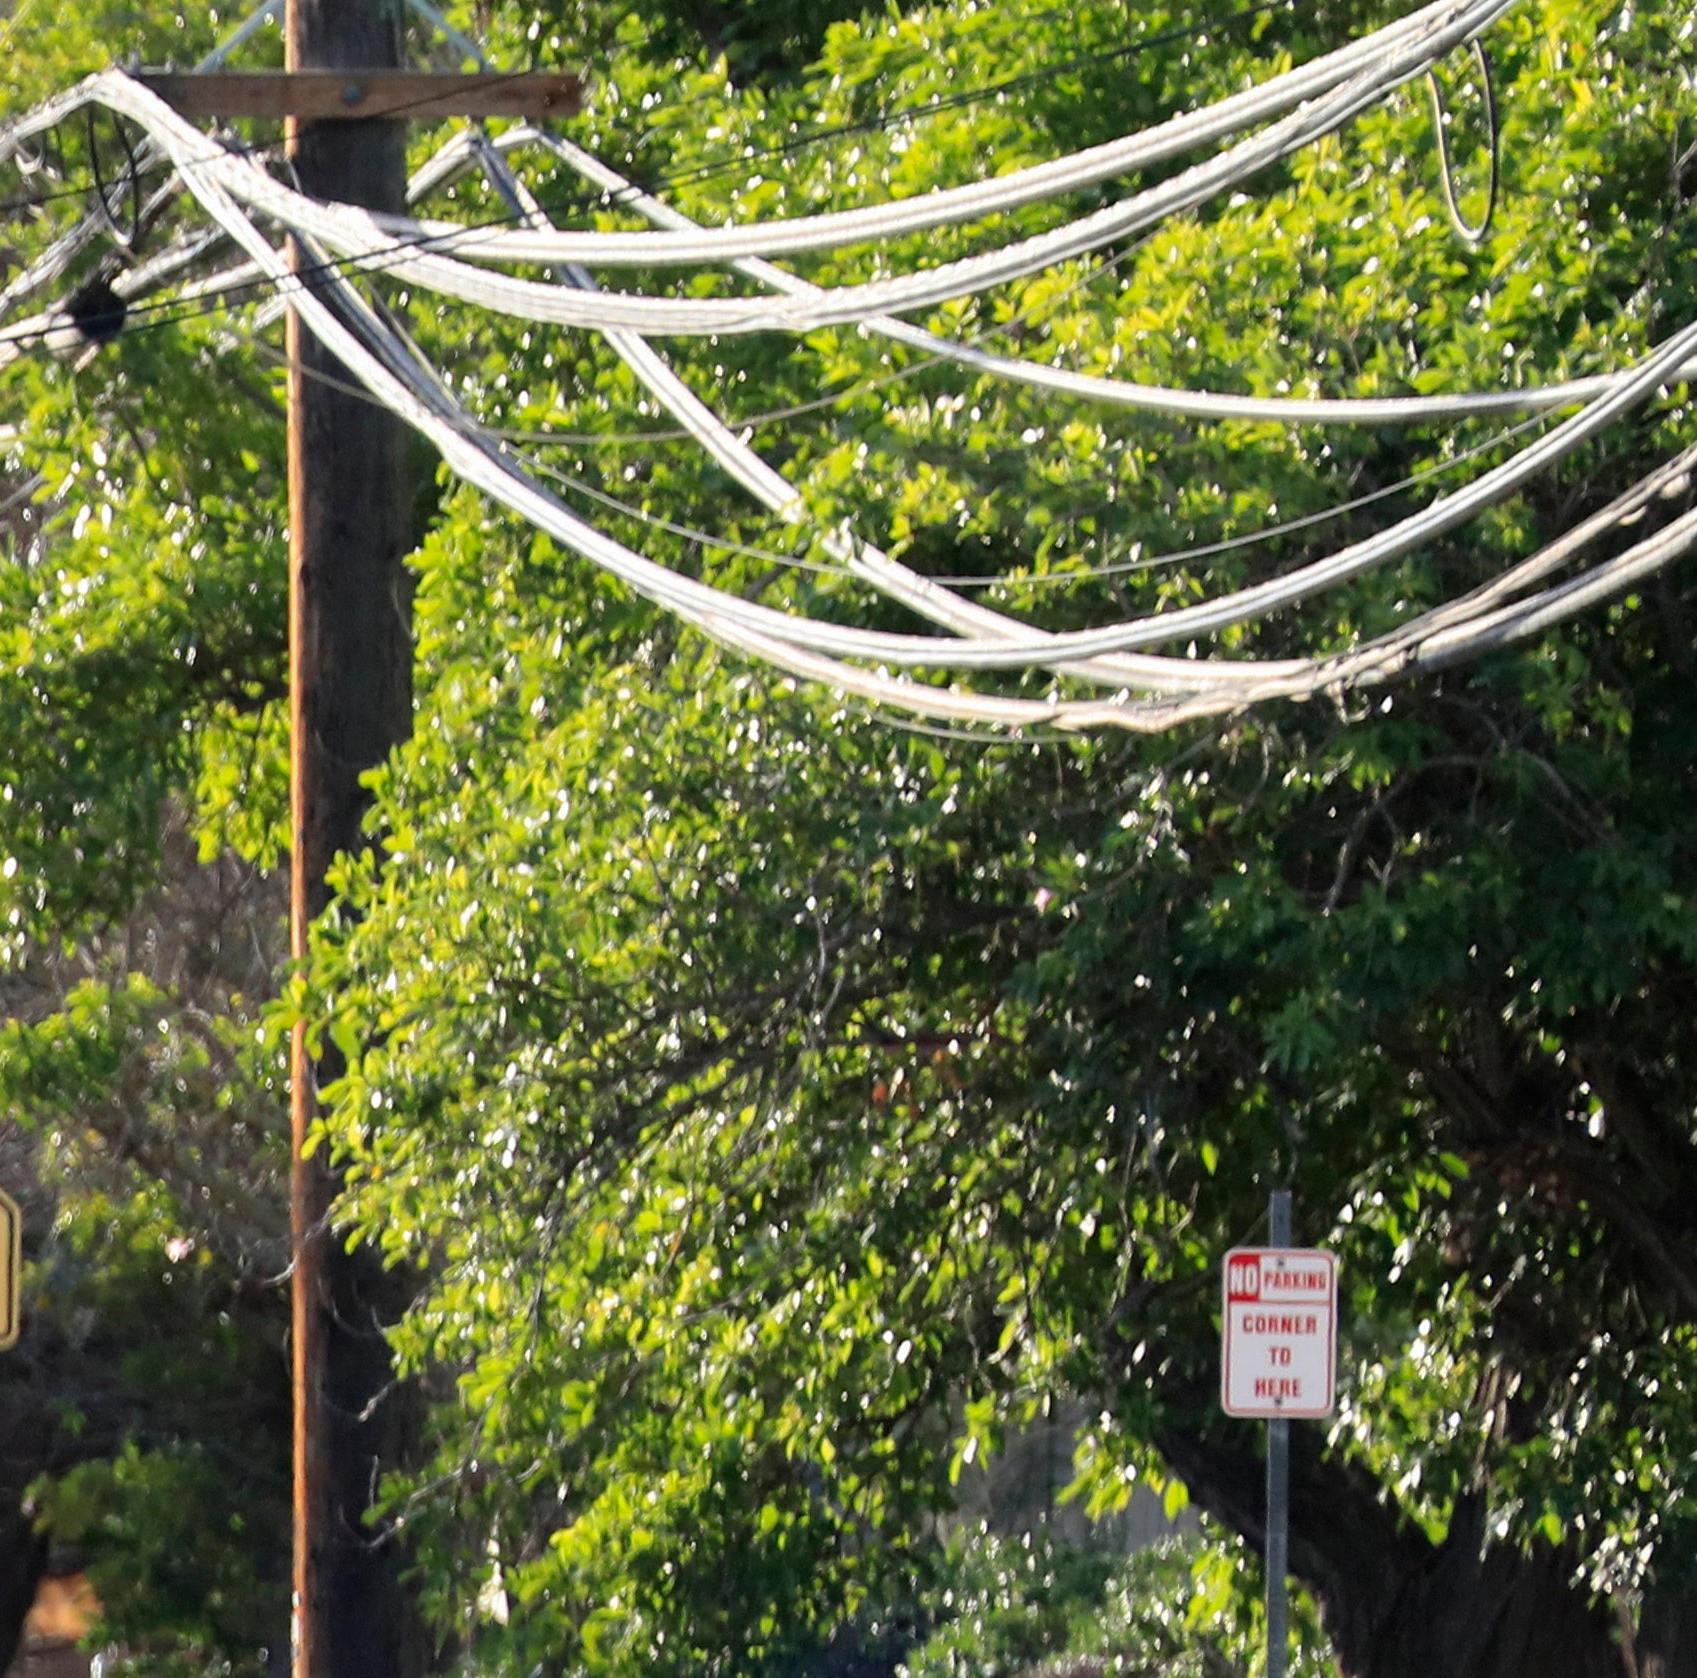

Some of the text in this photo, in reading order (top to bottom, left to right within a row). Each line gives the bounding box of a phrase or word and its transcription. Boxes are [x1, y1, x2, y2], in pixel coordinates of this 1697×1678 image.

[1230, 1263, 1327, 1295] NO PARKING
[1243, 1315, 1318, 1334] CORNER
[1268, 1347, 1291, 1366] TO
[1255, 1378, 1302, 1398] HERE
